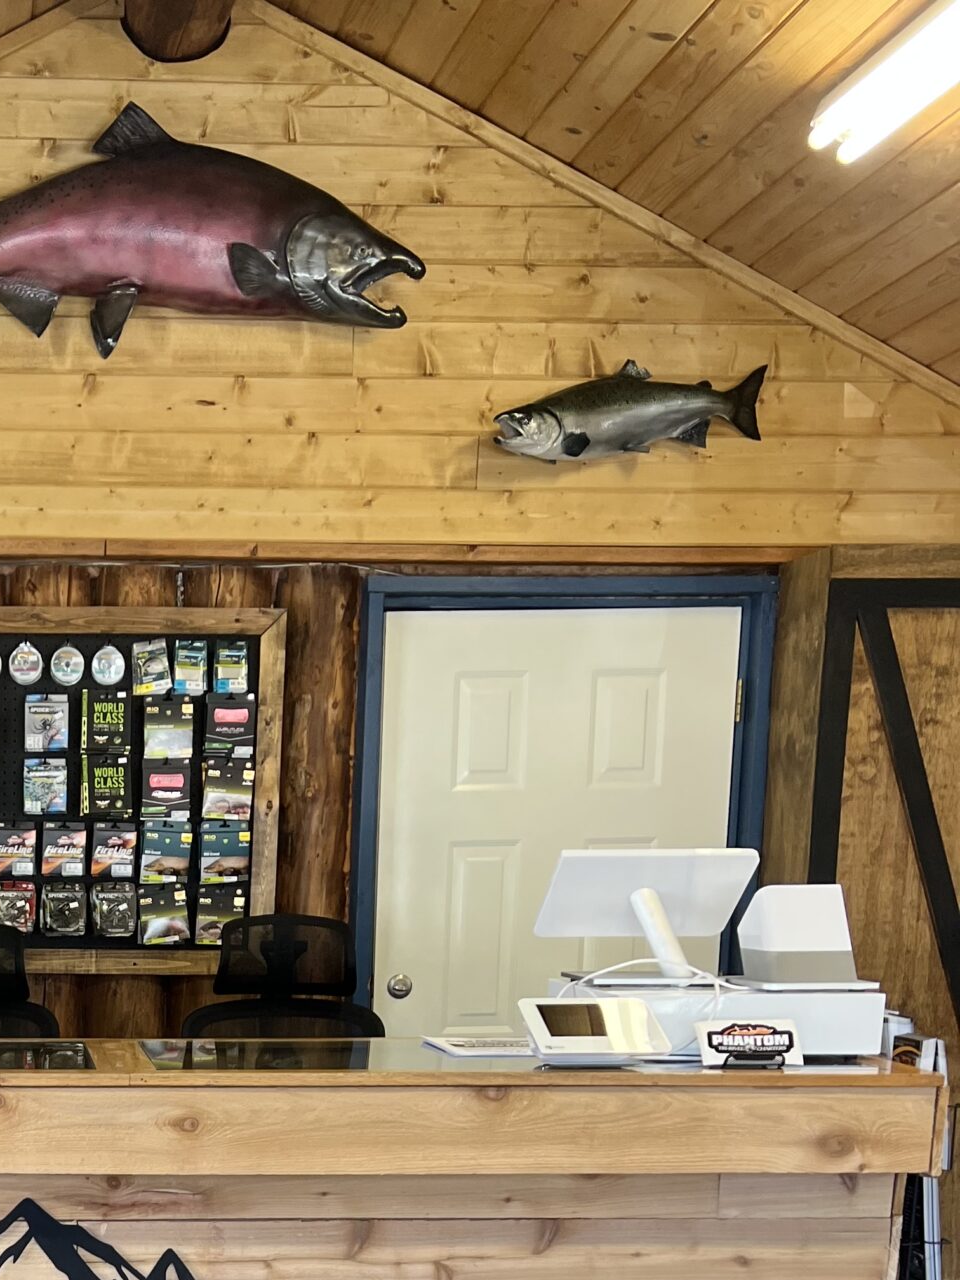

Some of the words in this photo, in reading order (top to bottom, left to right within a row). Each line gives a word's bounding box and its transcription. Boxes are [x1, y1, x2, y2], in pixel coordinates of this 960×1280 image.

[93, 702, 125, 713] WORLD
[93, 712, 125, 724] CLASS
[94, 767, 125, 777] WORLD
[94, 777, 125, 788] CLASS
[44, 844, 83, 854] FireLine
[95, 845, 133, 855] FireLine
[711, 1034, 790, 1046] PHANTOM
